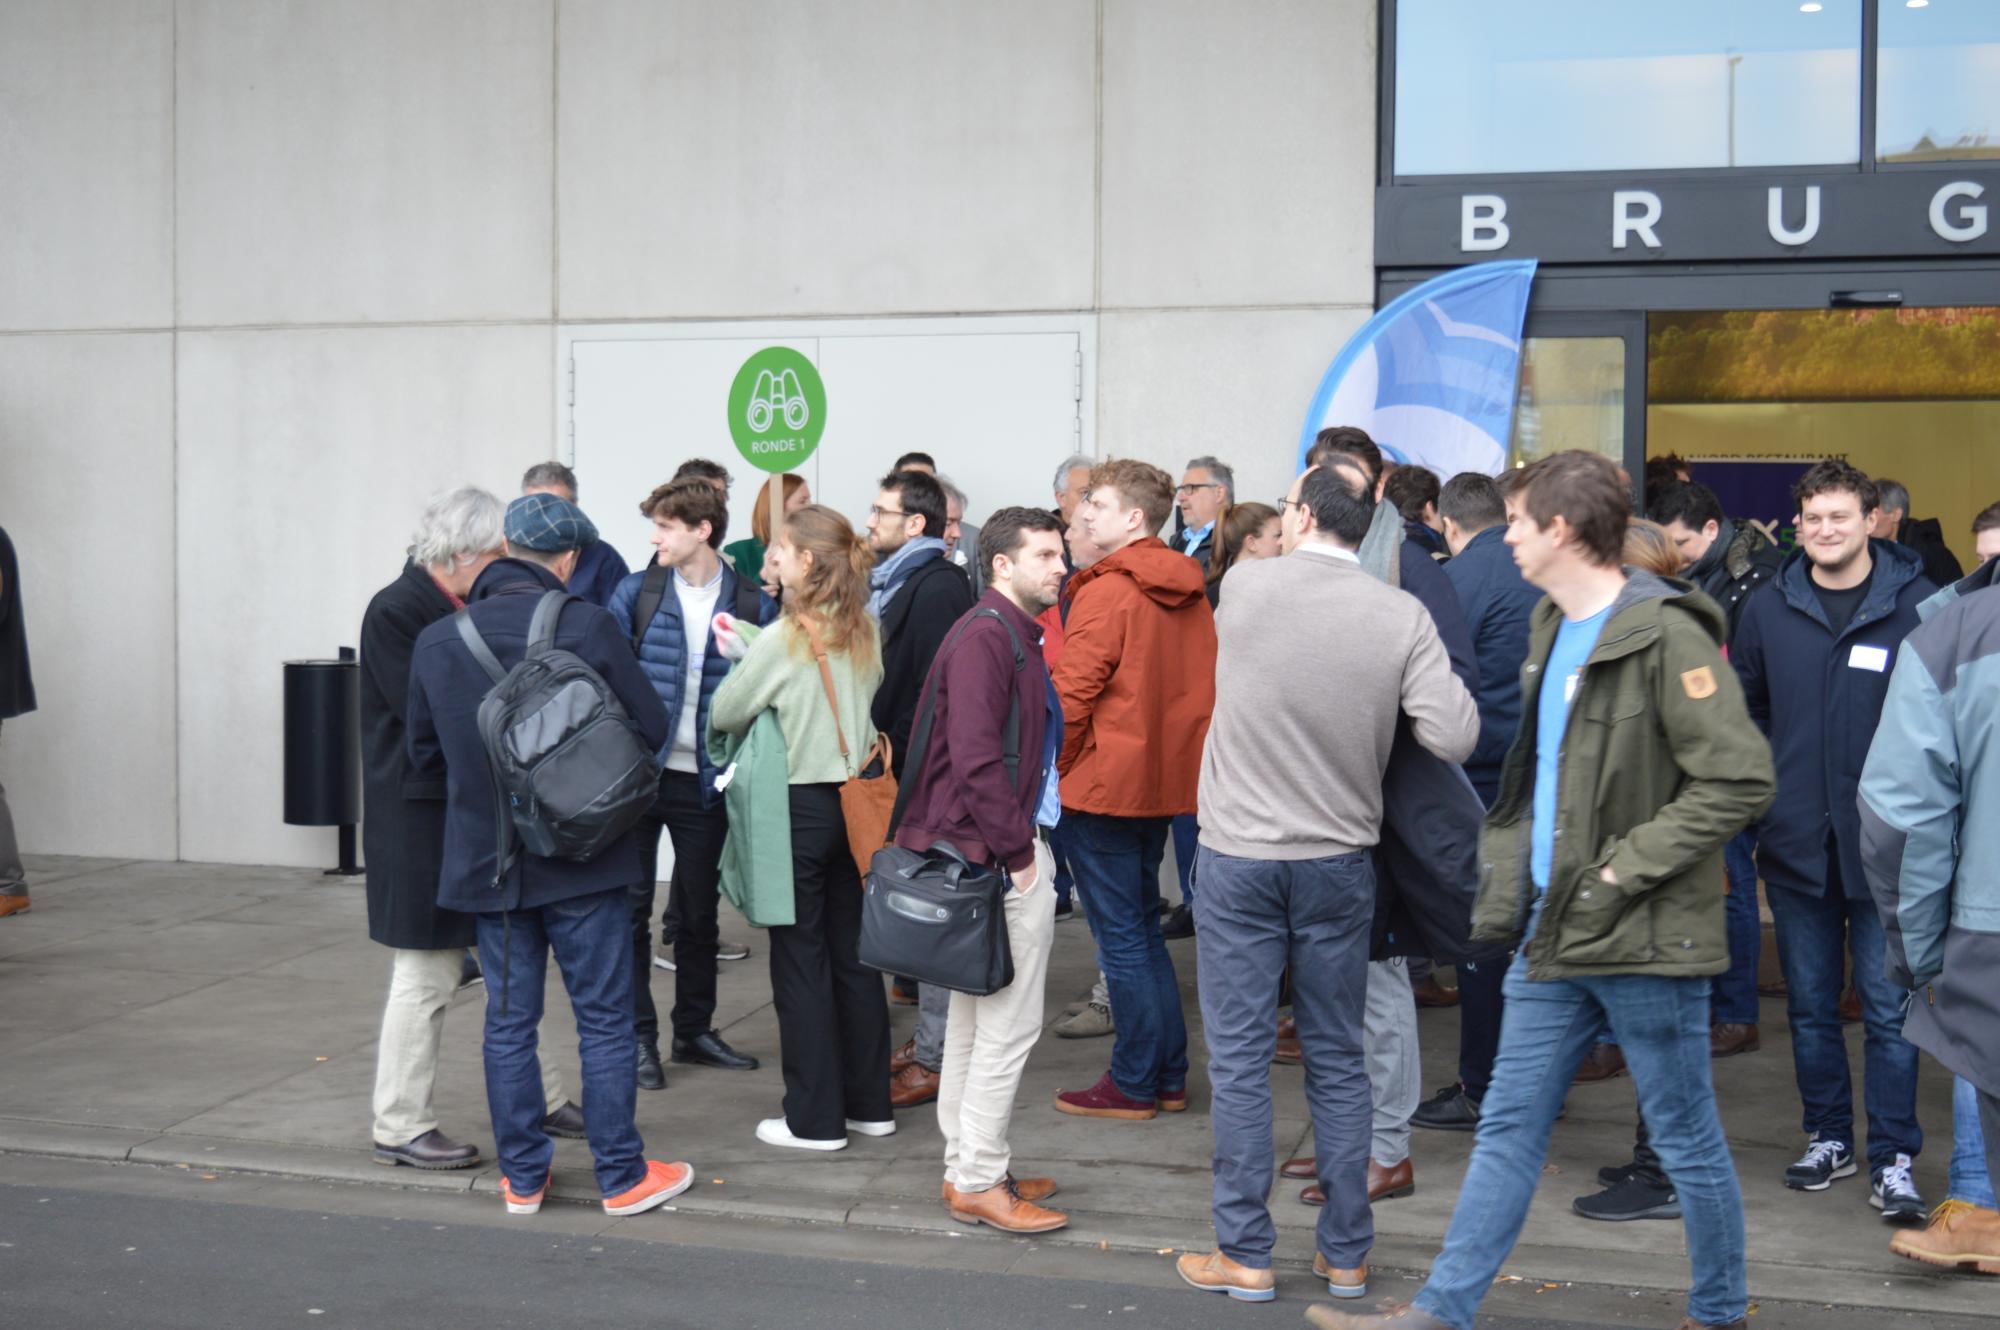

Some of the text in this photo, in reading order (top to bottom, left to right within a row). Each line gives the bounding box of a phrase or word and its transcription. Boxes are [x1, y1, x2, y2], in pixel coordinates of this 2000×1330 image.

[1461, 181, 1988, 251] BRUG
[752, 438, 805, 454] RONDE 1
